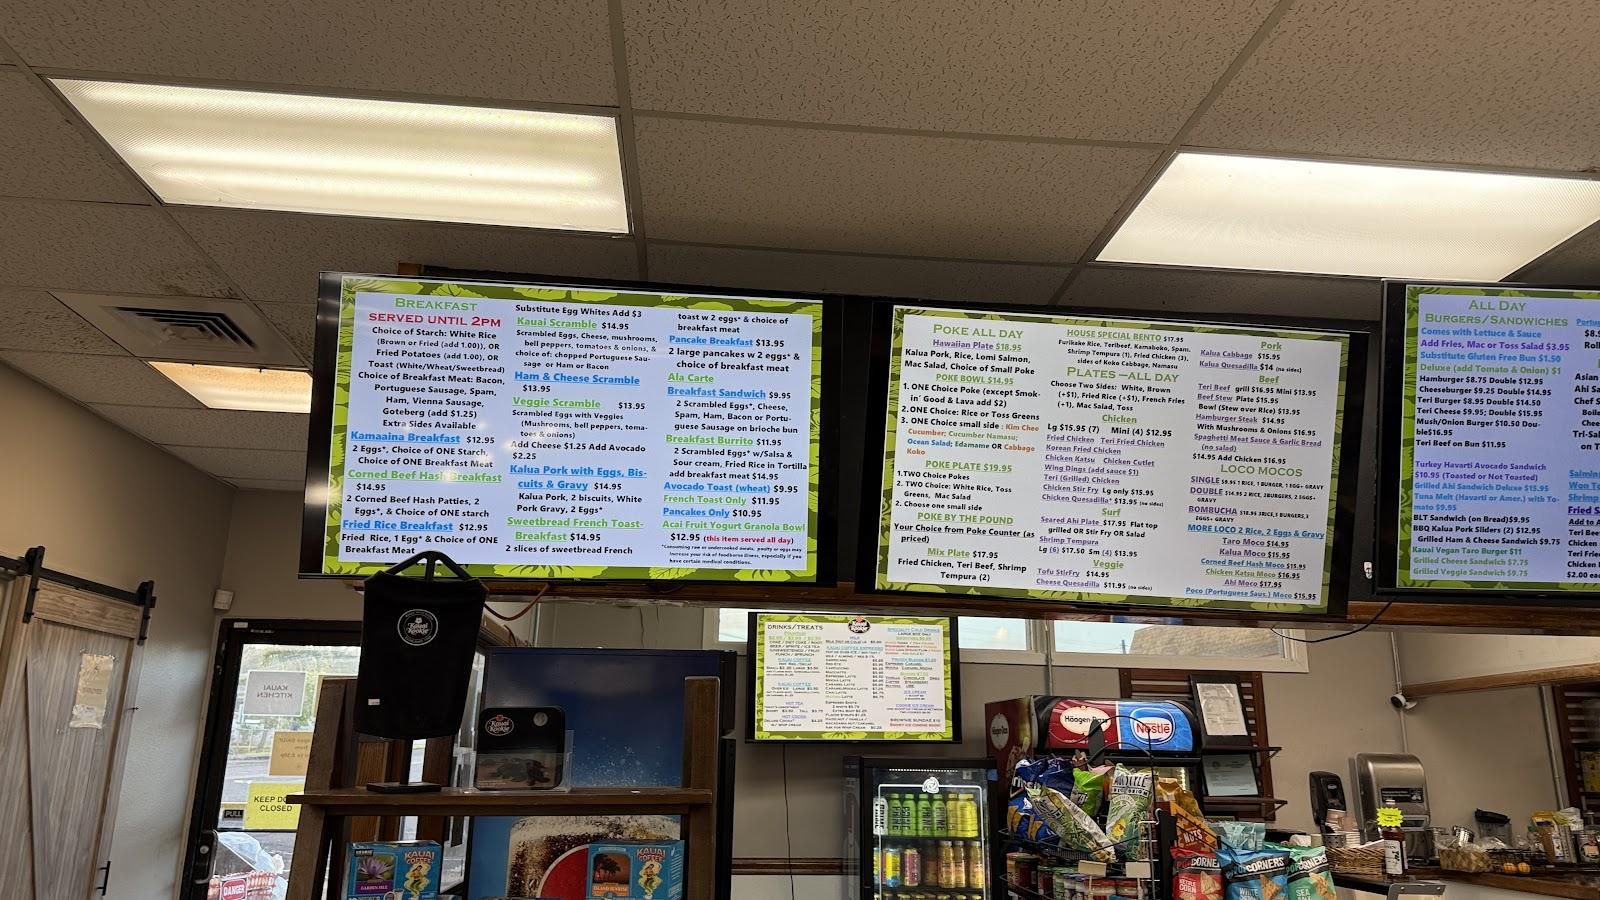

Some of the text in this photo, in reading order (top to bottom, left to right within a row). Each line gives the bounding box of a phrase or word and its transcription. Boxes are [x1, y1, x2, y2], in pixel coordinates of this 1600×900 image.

[516, 305, 559, 313] Substitute
[563, 307, 578, 316] Egg
[581, 308, 610, 316] Whites
[369, 313, 500, 327] SERVED UNTIL 2PM
[517, 317, 546, 327] Kauai
[550, 318, 597, 329] Scramble
[934, 324, 1023, 338] POKE ALL DAY
[1067, 330, 1095, 338] HOUSE
[1098, 331, 1130, 340] SPECIAL
[1134, 334, 1161, 342] BENTO
[670, 336, 707, 345] Pancake
[710, 337, 753, 346] Breakfast
[933, 340, 1021, 351] Hawaiian Plate $18.95
[1261, 342, 1282, 350] Pork
[955, 352, 973, 360] Rice,
[998, 355, 1030, 363] Salmon,
[1223, 351, 1252, 359] Cabbage
[515, 372, 639, 385] Ham & Cheese Scramble
[1067, 367, 1115, 378] PLATES
[1155, 374, 1179, 382] DAY
[961, 375, 985, 383] BOWL
[988, 377, 1013, 385] $14.95
[1259, 376, 1279, 384] Beef
[668, 387, 714, 396] Breakfast
[719, 389, 766, 398] Sandwich
[1102, 415, 1136, 424] Chicken
[1048, 424, 1057, 432] Lg
[351, 432, 405, 442] Kamaaina
[408, 433, 460, 443] Breakfast
[666, 435, 714, 445] Breakfast
[718, 436, 753, 445] Burrito
[926, 460, 1012, 472] POKE PLATE $19.95
[1416, 461, 1441, 469] Turkey
[510, 465, 540, 475] Kalua
[543, 466, 567, 476] Pork
[570, 467, 593, 476] with
[597, 468, 624, 478] Eggs,
[1221, 465, 1302, 477] LOCO MOCOS
[1191, 476, 1220, 484] SINGLE
[664, 482, 797, 493] Avocado Toast (wheat) $9.95
[1191, 487, 1223, 495] DOUBLE
[1102, 508, 1120, 516] Surf
[1189, 506, 1237, 515] BOMBUCHA
[507, 517, 570, 527] Sweetbread
[574, 519, 607, 528] French
[918, 513, 942, 521] POKE
[944, 514, 956, 522] BY
[980, 516, 1013, 524] POUND
[343, 520, 370, 528] Fried
[375, 521, 397, 530] Rice
[401, 521, 452, 531] Breakfast
[516, 531, 600, 541] Breakfast $14.95
[1222, 537, 1240, 545] Taro
[928, 548, 944, 556] Mix
[948, 549, 970, 557] Plate
[1244, 550, 1265, 558] Moco
[1093, 560, 1124, 569] Veggie
